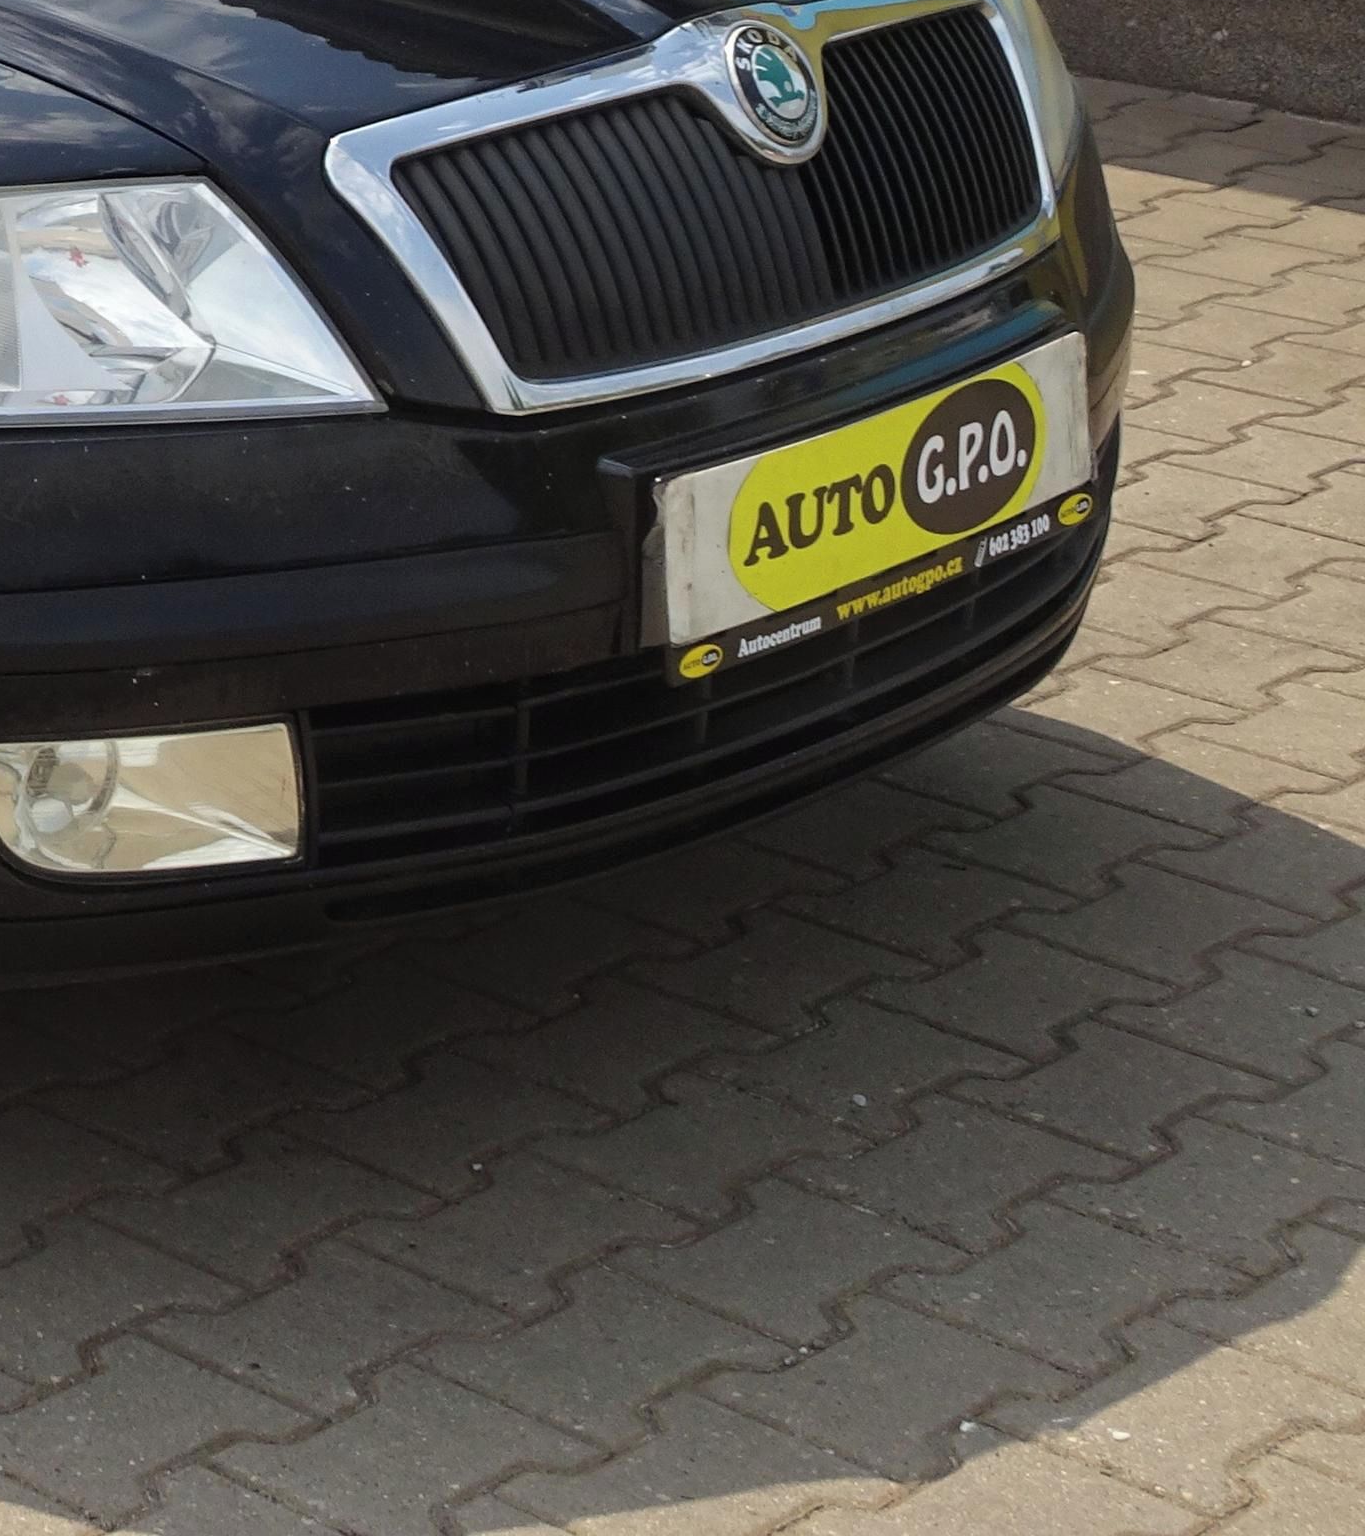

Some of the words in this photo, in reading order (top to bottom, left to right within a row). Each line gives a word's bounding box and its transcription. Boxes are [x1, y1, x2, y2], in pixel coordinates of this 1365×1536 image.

[743, 463, 896, 567] AUTO
[916, 409, 1027, 505] G.P.O.
[737, 615, 822, 659] Autocentrum
[836, 556, 963, 620] www.autogpo.cz
